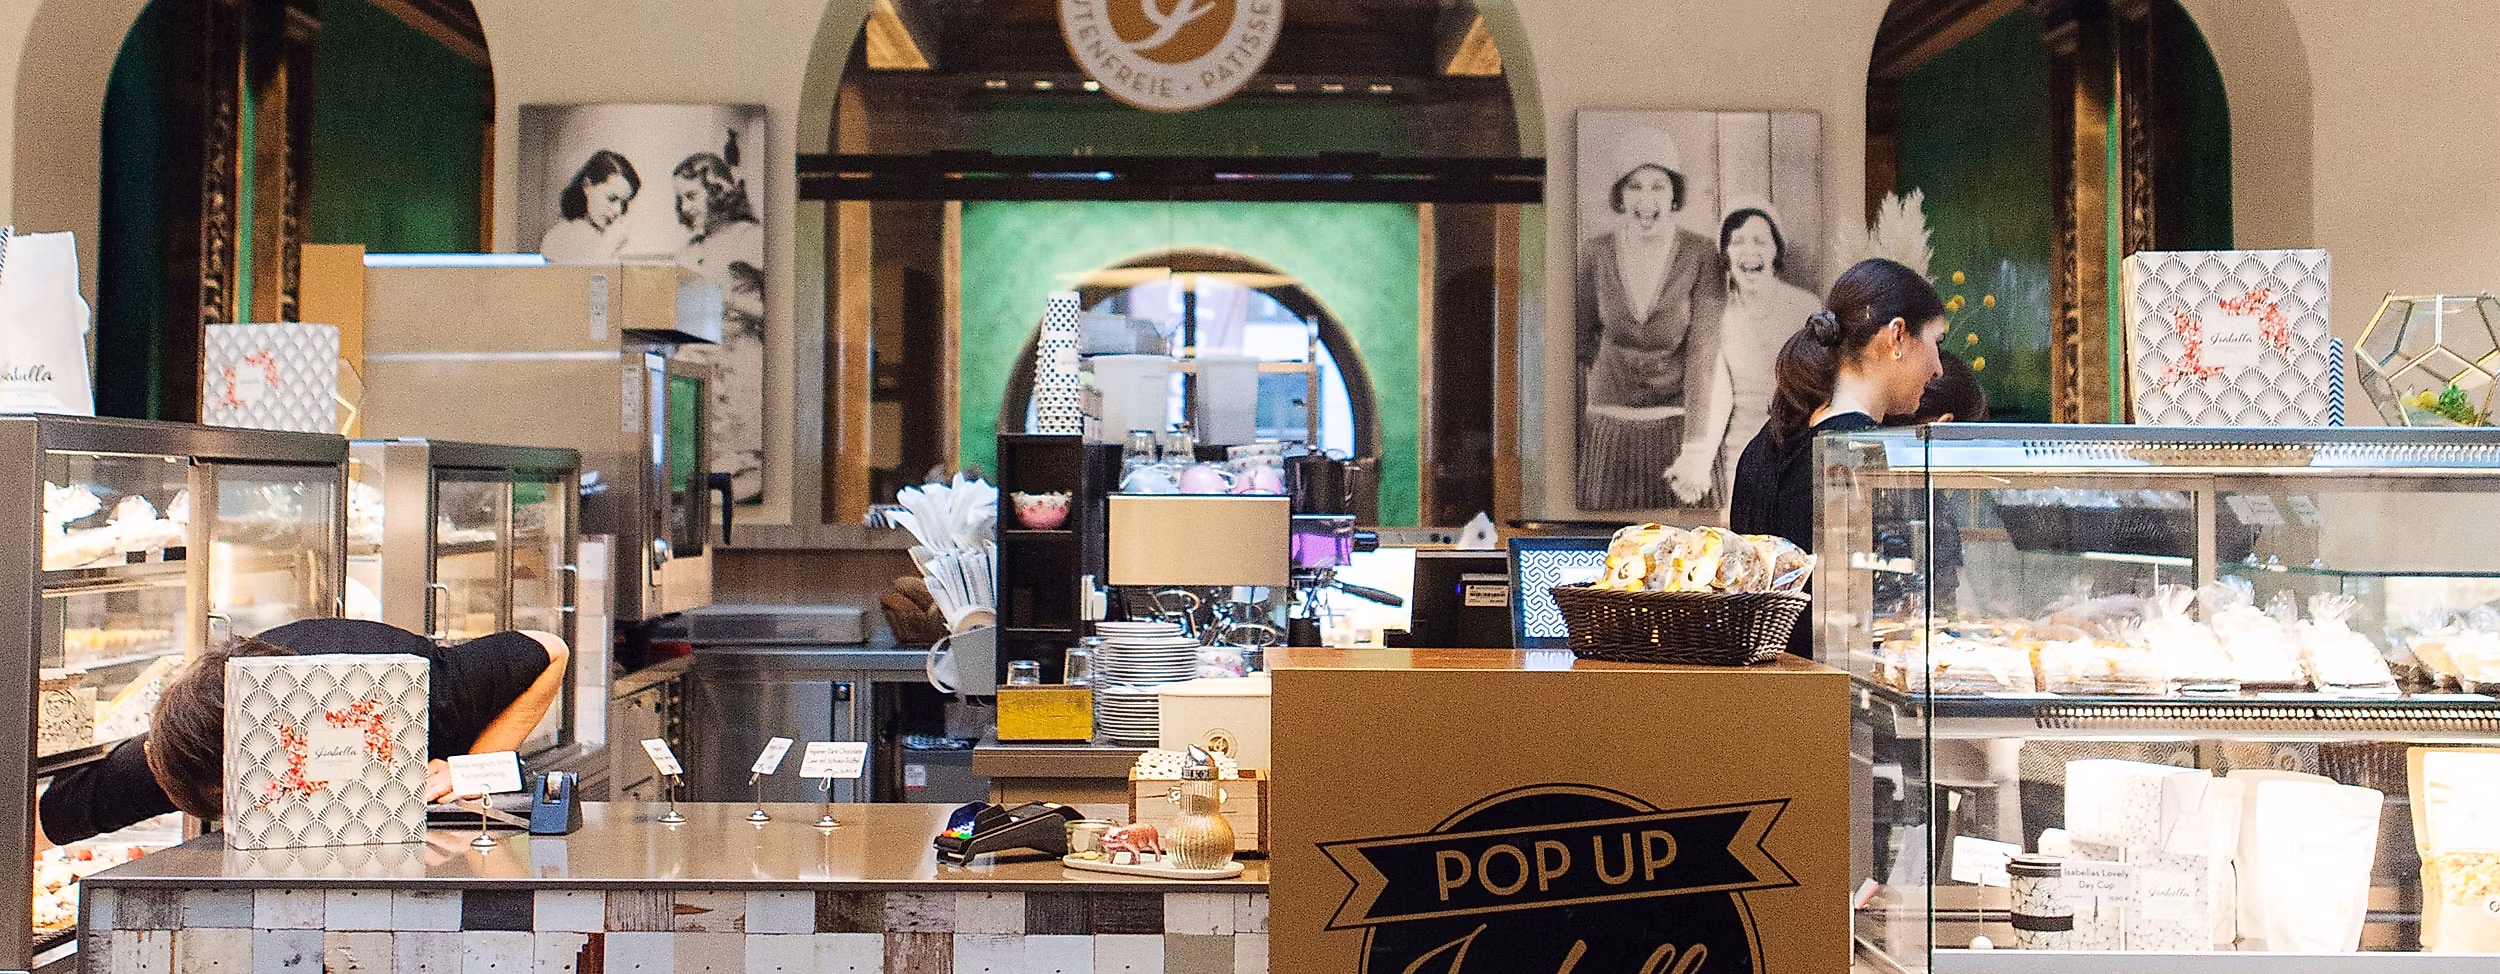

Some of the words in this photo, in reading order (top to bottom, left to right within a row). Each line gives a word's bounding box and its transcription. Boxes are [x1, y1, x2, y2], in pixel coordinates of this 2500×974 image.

[314, 746, 356, 759] Isabella
[1435, 840, 1571, 901] POP
[1593, 830, 1678, 884] UP
[2063, 868, 2100, 877] Isabellas
[2102, 869, 2129, 880] Lovely
[2078, 880, 2094, 891] Day
[2097, 880, 2115, 891] Cup
